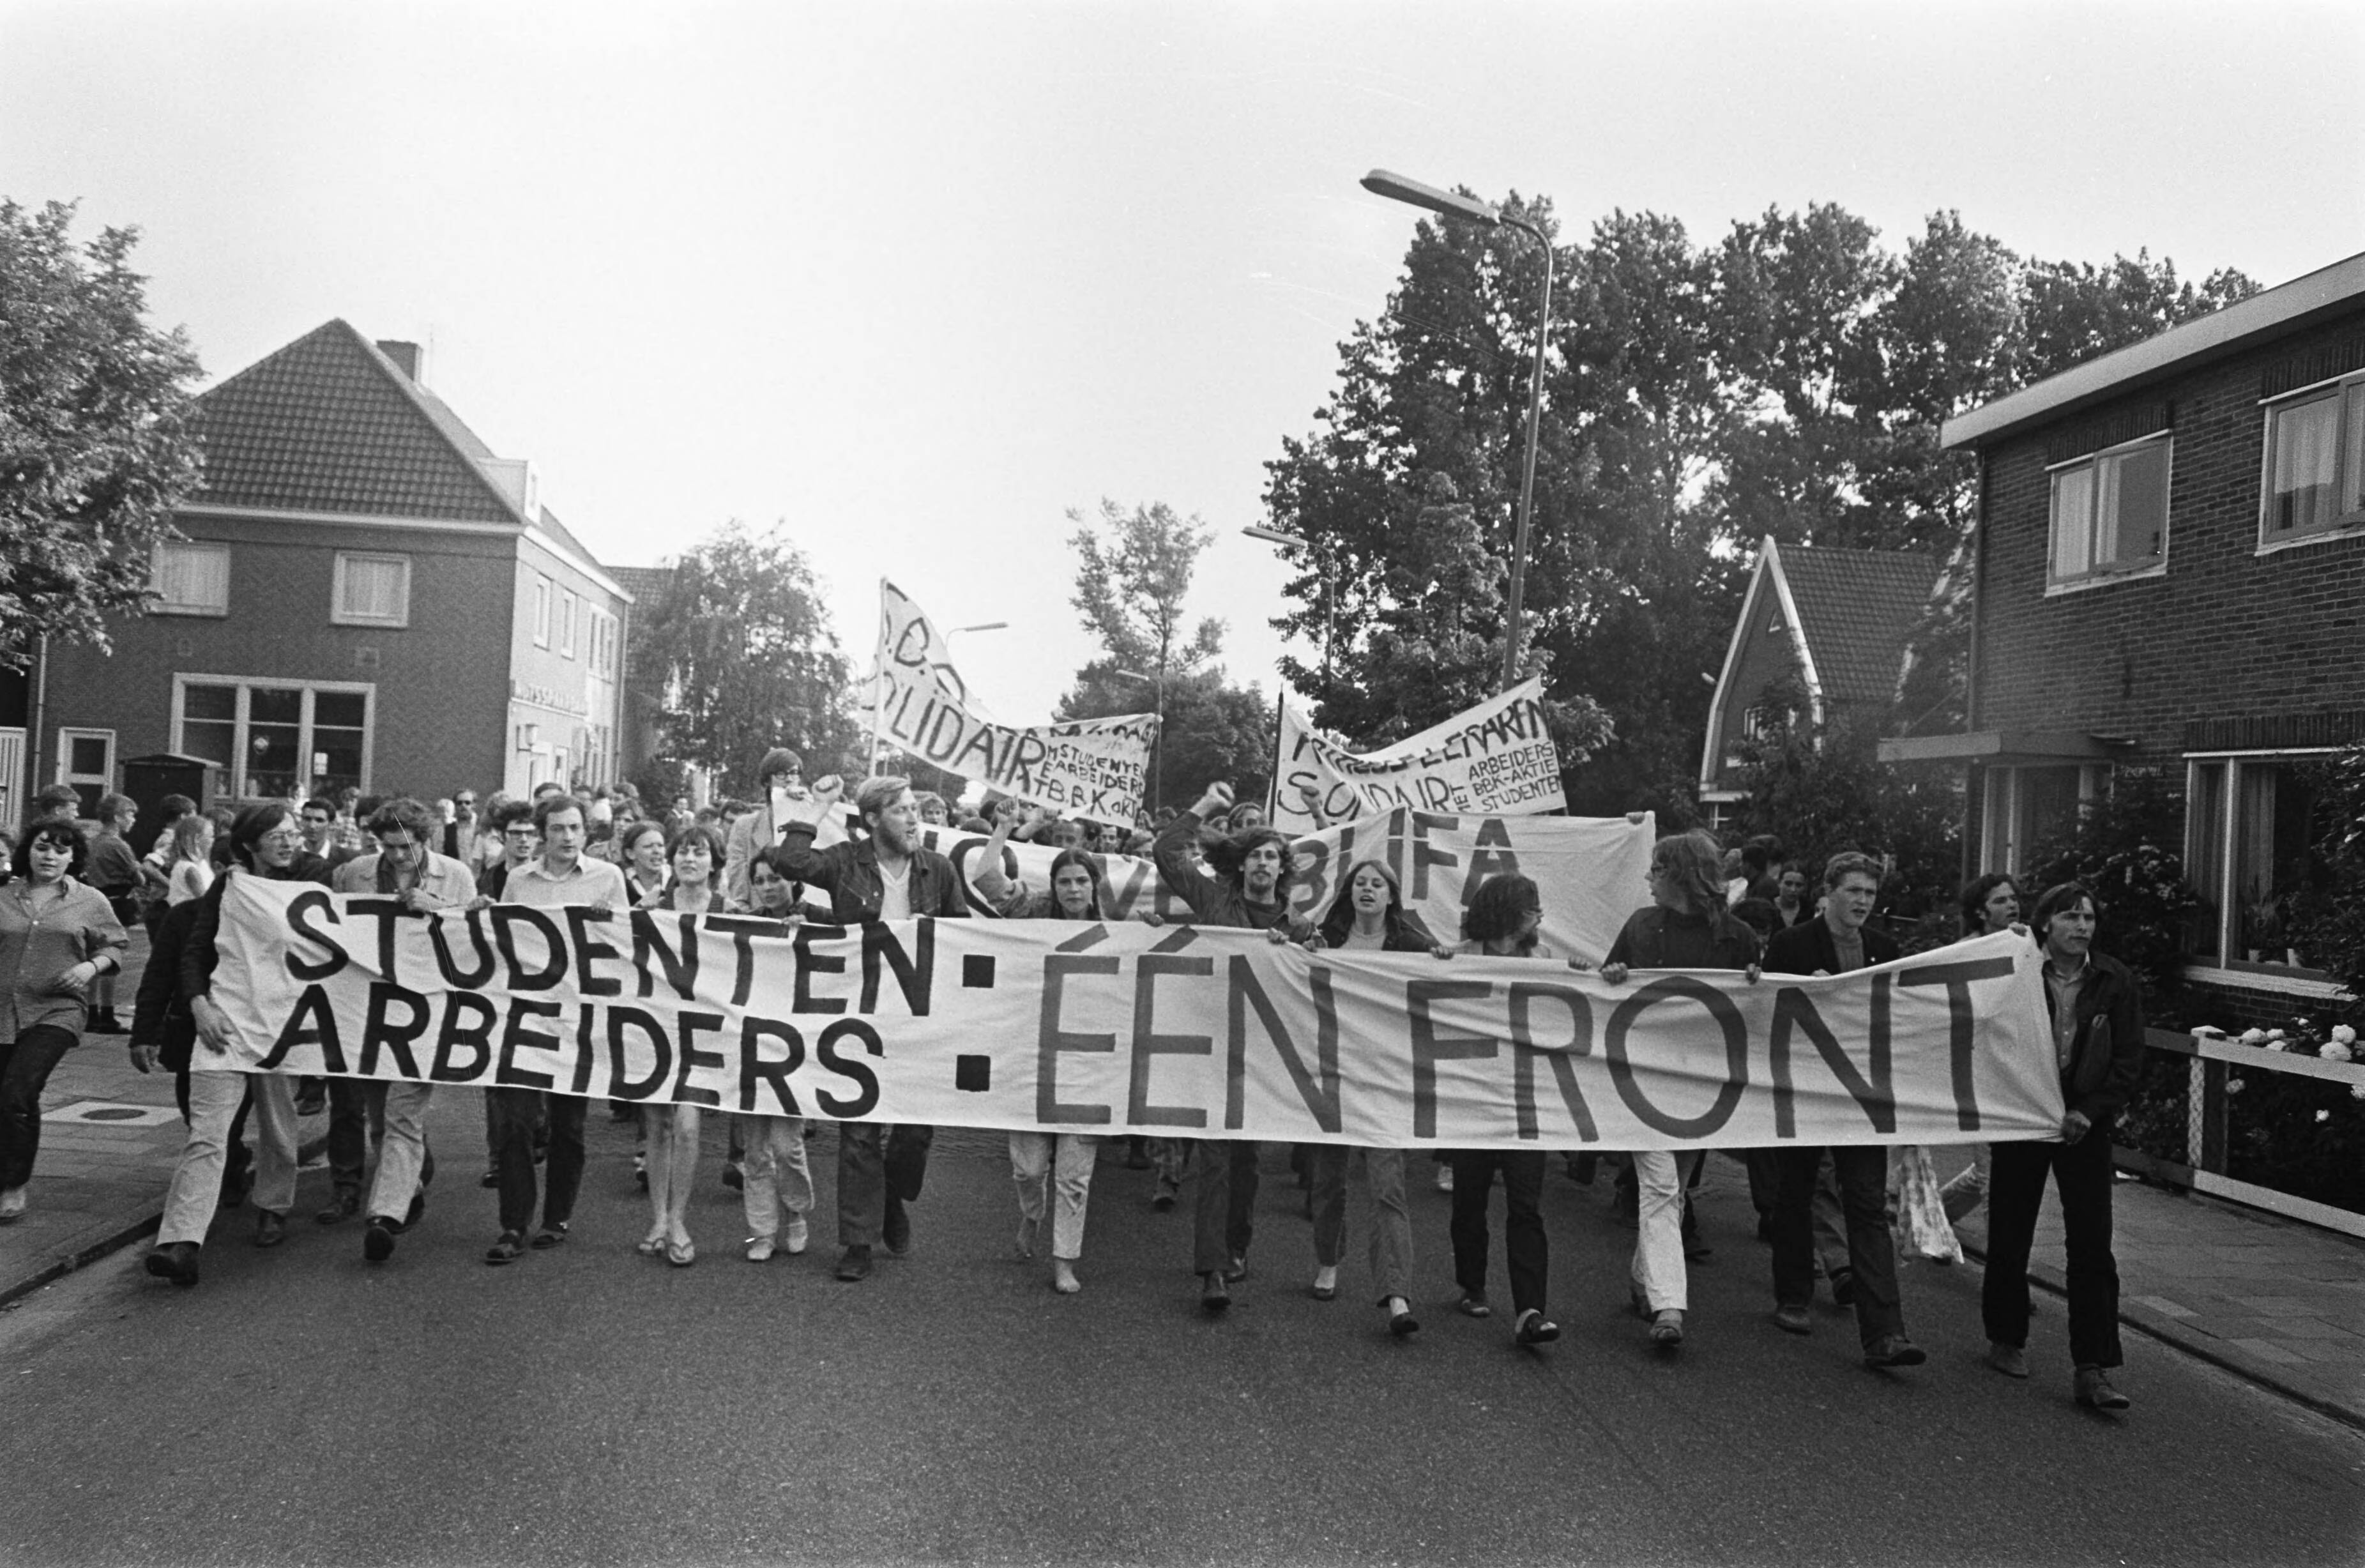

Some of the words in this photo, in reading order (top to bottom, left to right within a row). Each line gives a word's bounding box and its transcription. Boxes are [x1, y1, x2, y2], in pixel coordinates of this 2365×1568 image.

[1469, 741, 1554, 781] ARBEIDERS
[1472, 758, 1558, 796] BBK-AKTIE
[286, 890, 936, 1017] STUDENTEN
[255, 983, 886, 1118] ARBEIDERS
[1036, 923, 1342, 1133] ÉÉN
[1406, 956, 2014, 1142] FRONT
